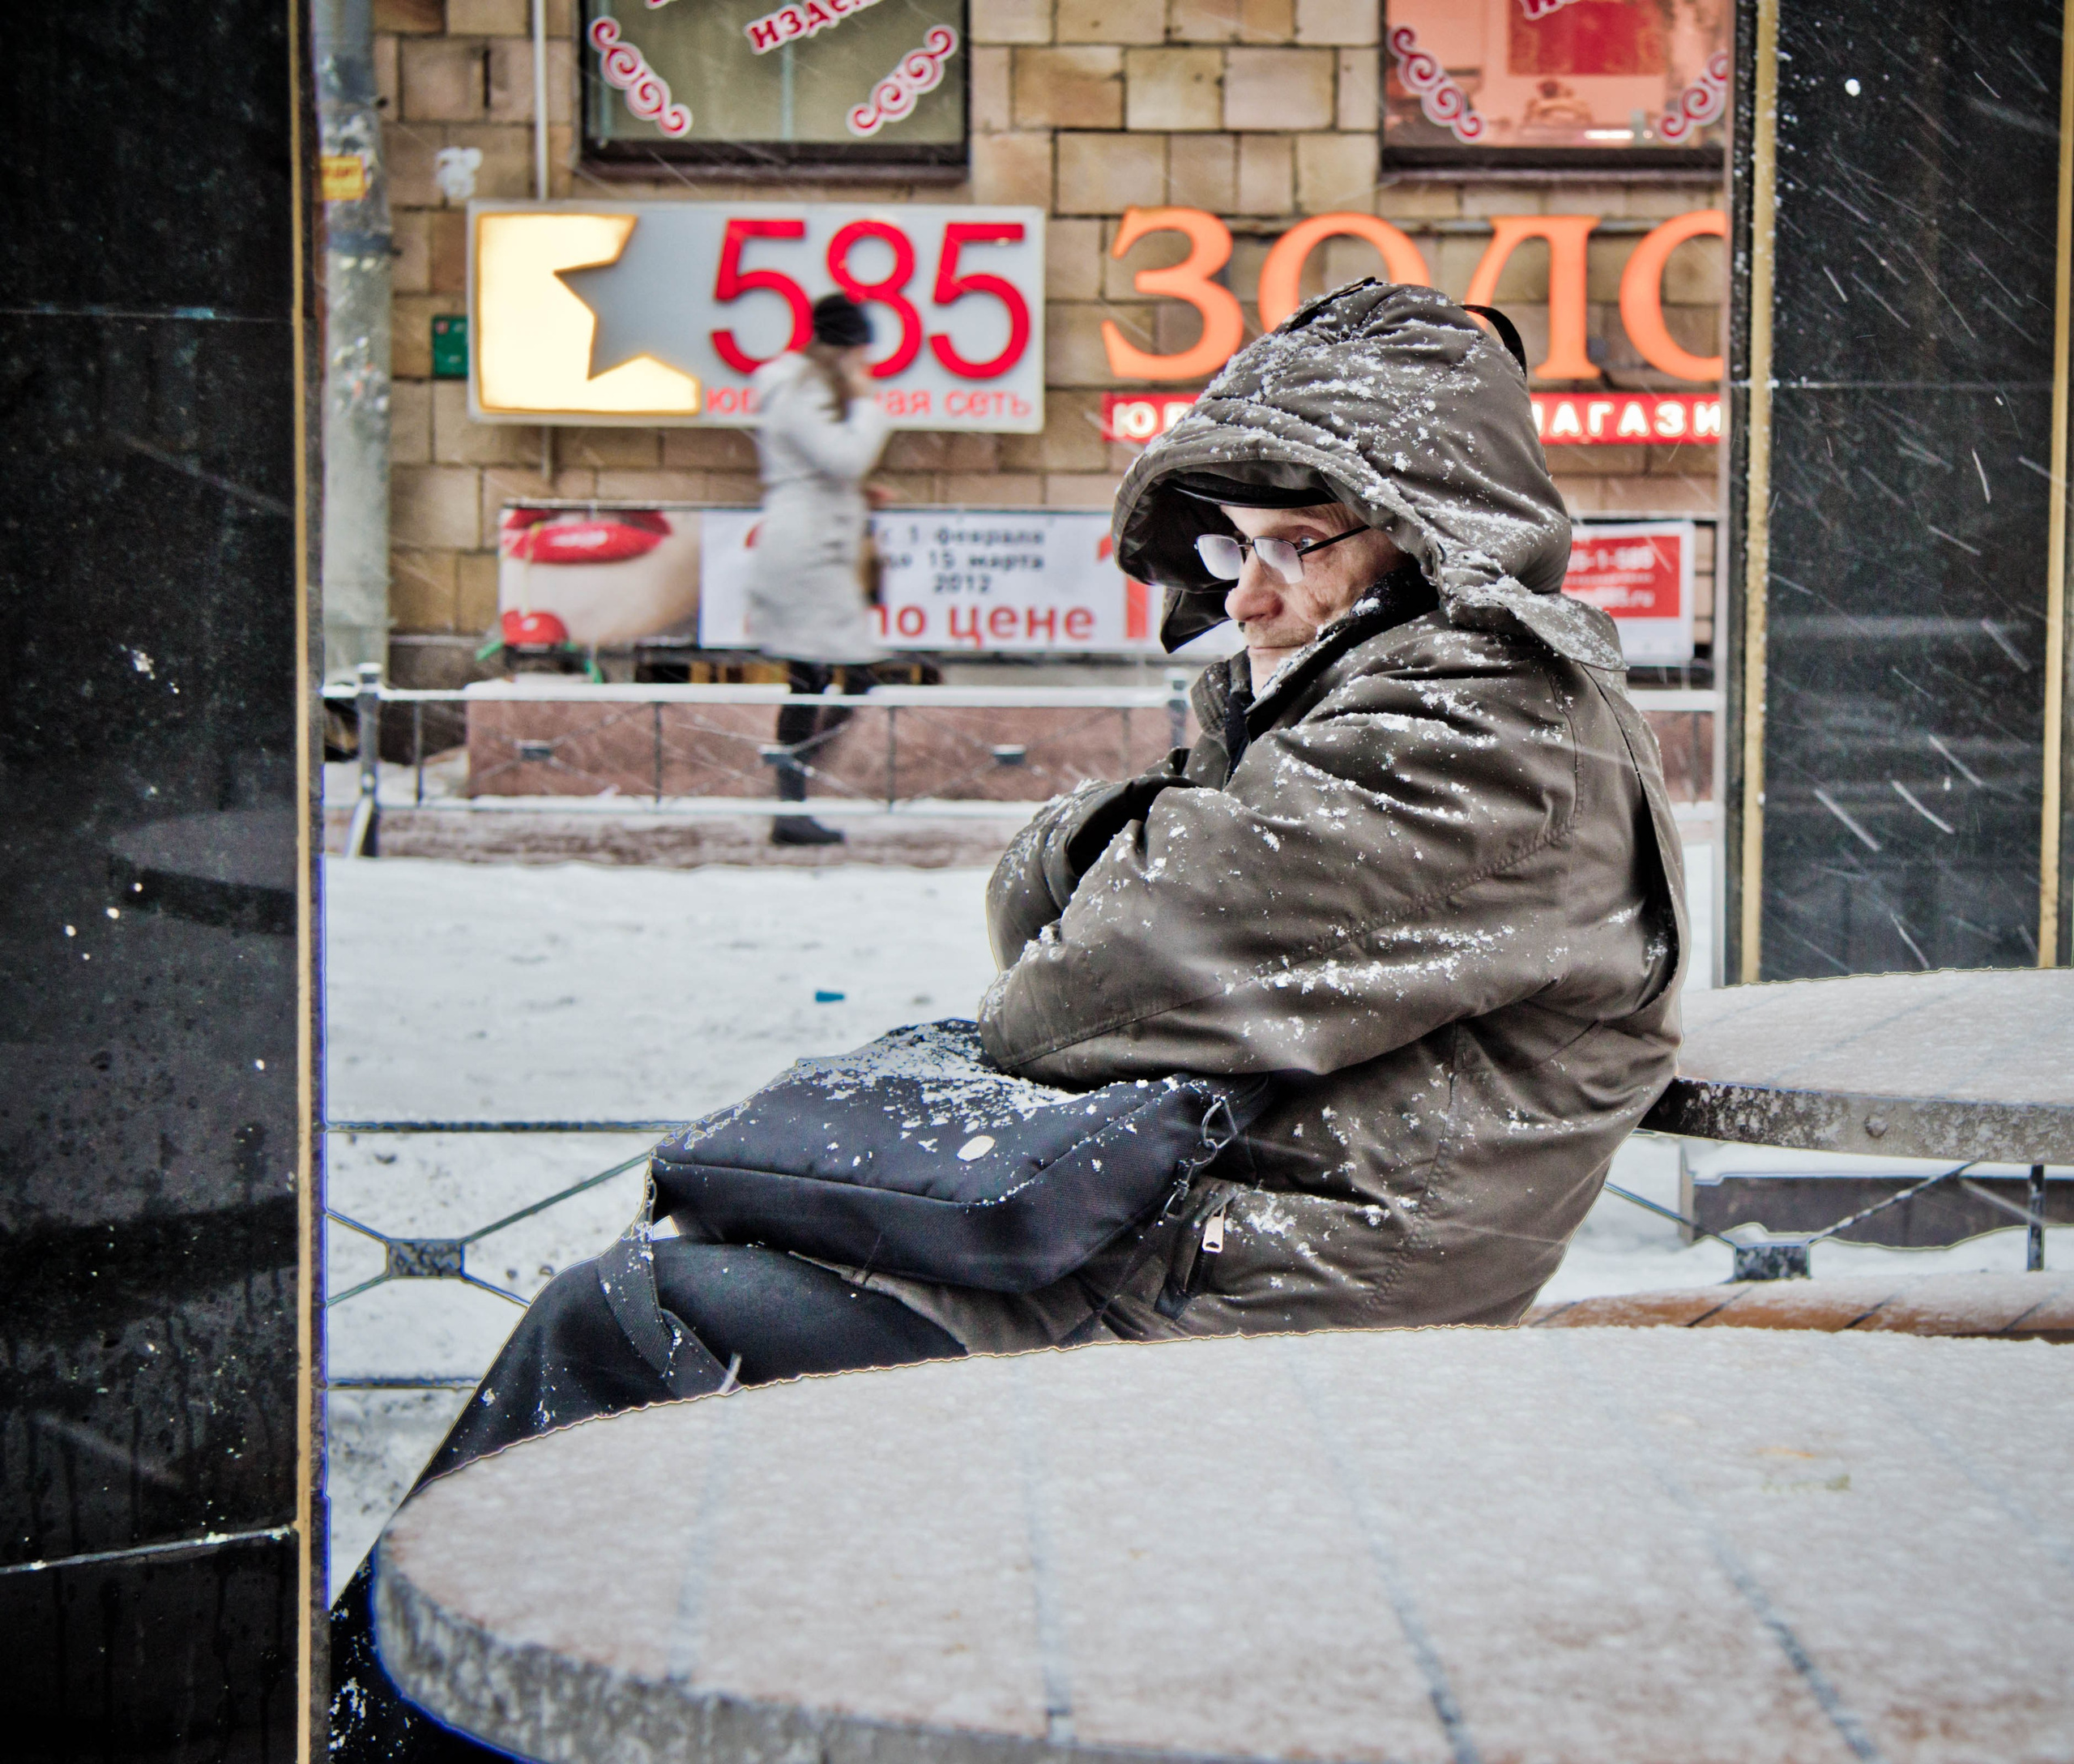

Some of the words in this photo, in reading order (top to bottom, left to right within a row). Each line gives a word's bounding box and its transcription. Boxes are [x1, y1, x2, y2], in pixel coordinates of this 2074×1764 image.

[710, 218, 1031, 379] 585
[944, 389, 1033, 420] сеть
[934, 526, 1045, 547] февраля
[929, 549, 956, 570] 15
[969, 554, 1045, 573] марта
[933, 573, 992, 595] 2012
[949, 604, 1095, 649] цене
